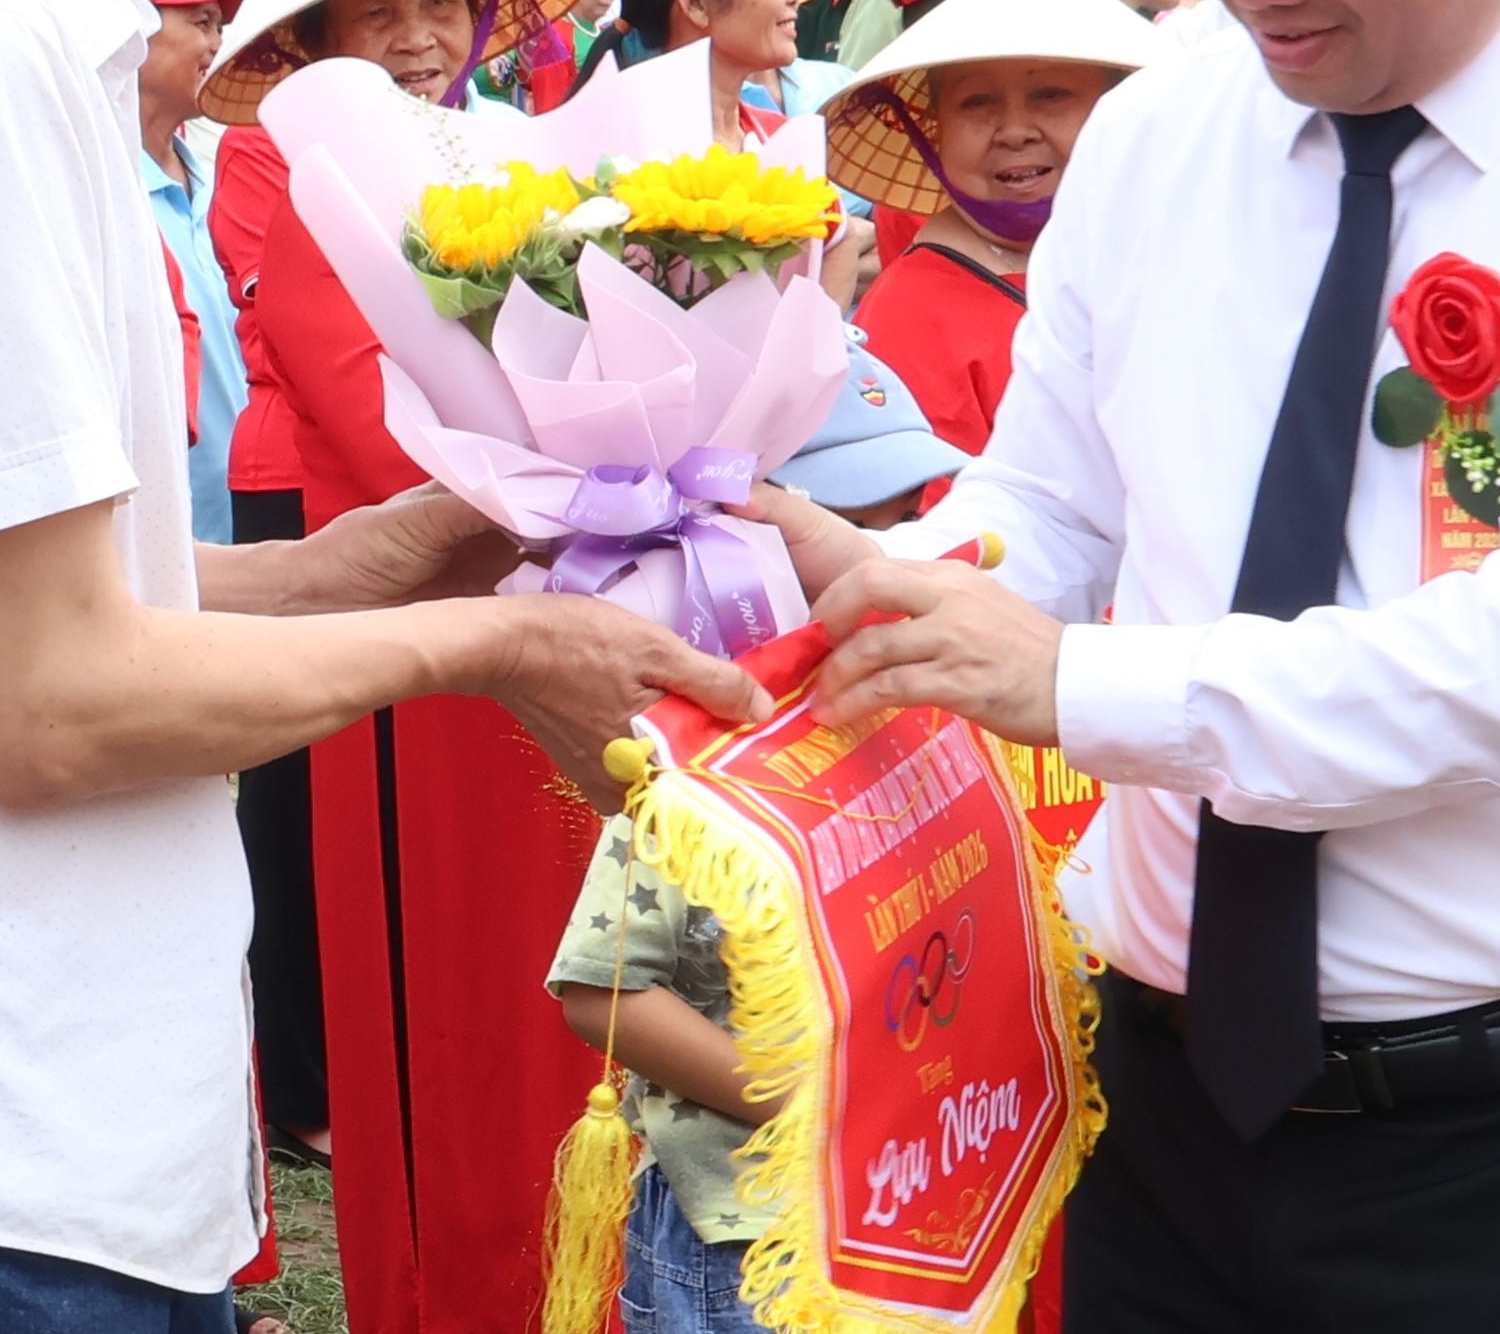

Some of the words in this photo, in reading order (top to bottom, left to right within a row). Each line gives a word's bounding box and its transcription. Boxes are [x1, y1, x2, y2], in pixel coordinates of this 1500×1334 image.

[929, 845, 962, 905] NĂM
[862, 1138, 931, 1228] Lưu
[938, 1078, 1021, 1177] Niệm
